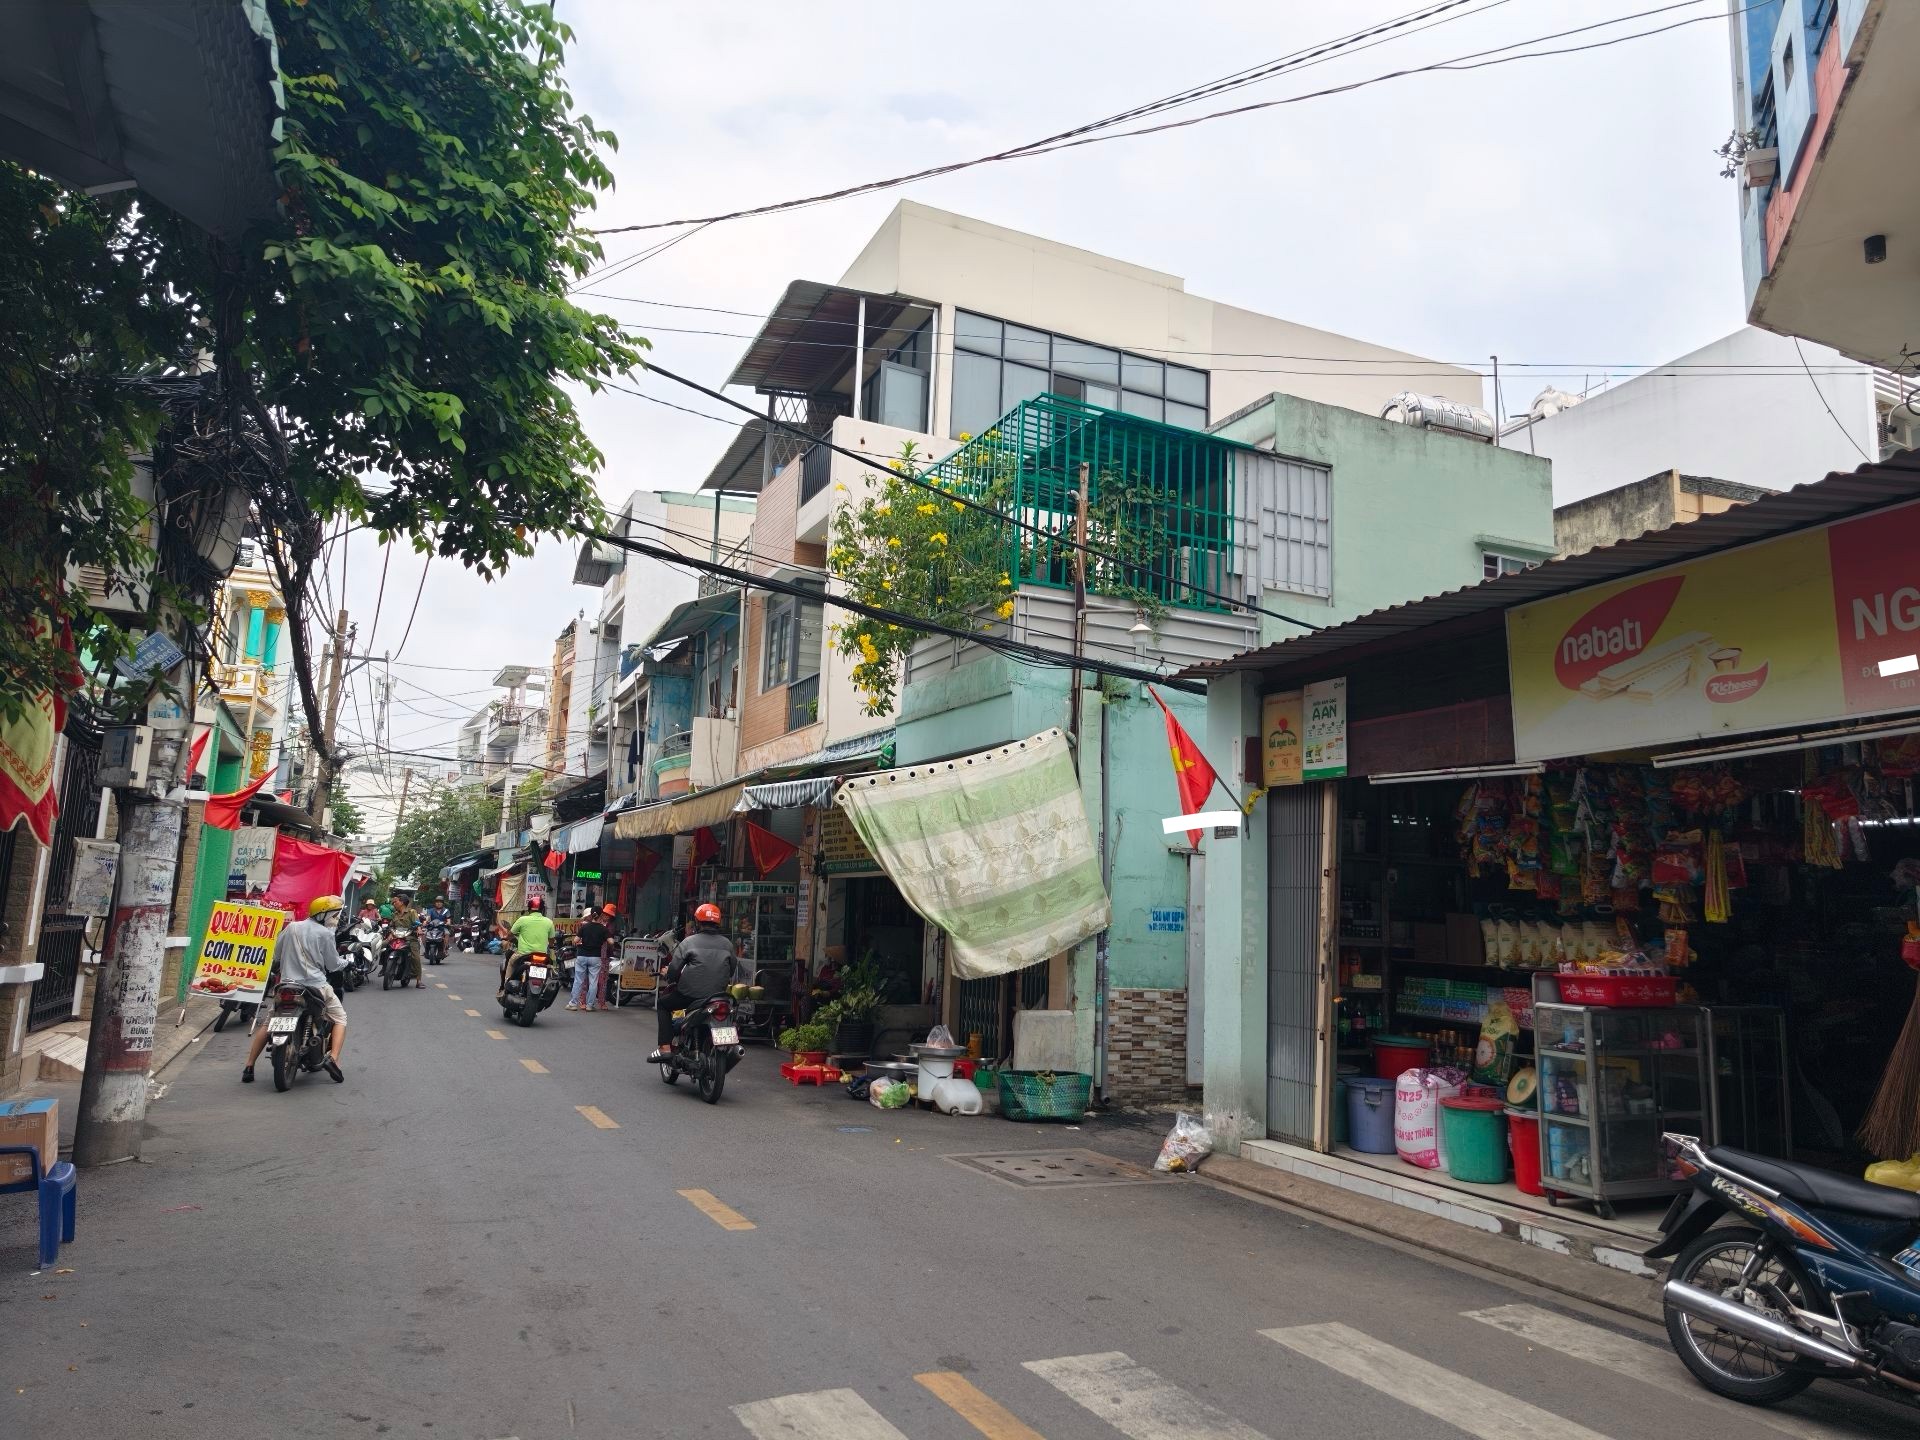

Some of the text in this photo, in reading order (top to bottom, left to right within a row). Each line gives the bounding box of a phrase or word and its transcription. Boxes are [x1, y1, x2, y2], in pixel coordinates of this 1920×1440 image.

[1563, 619, 1641, 664] nabati
[1312, 704, 1337, 721] AAN
[210, 908, 253, 937] QUÁN
[204, 940, 268, 966] CƠM TRƯA
[202, 962, 260, 980] 30-35K
